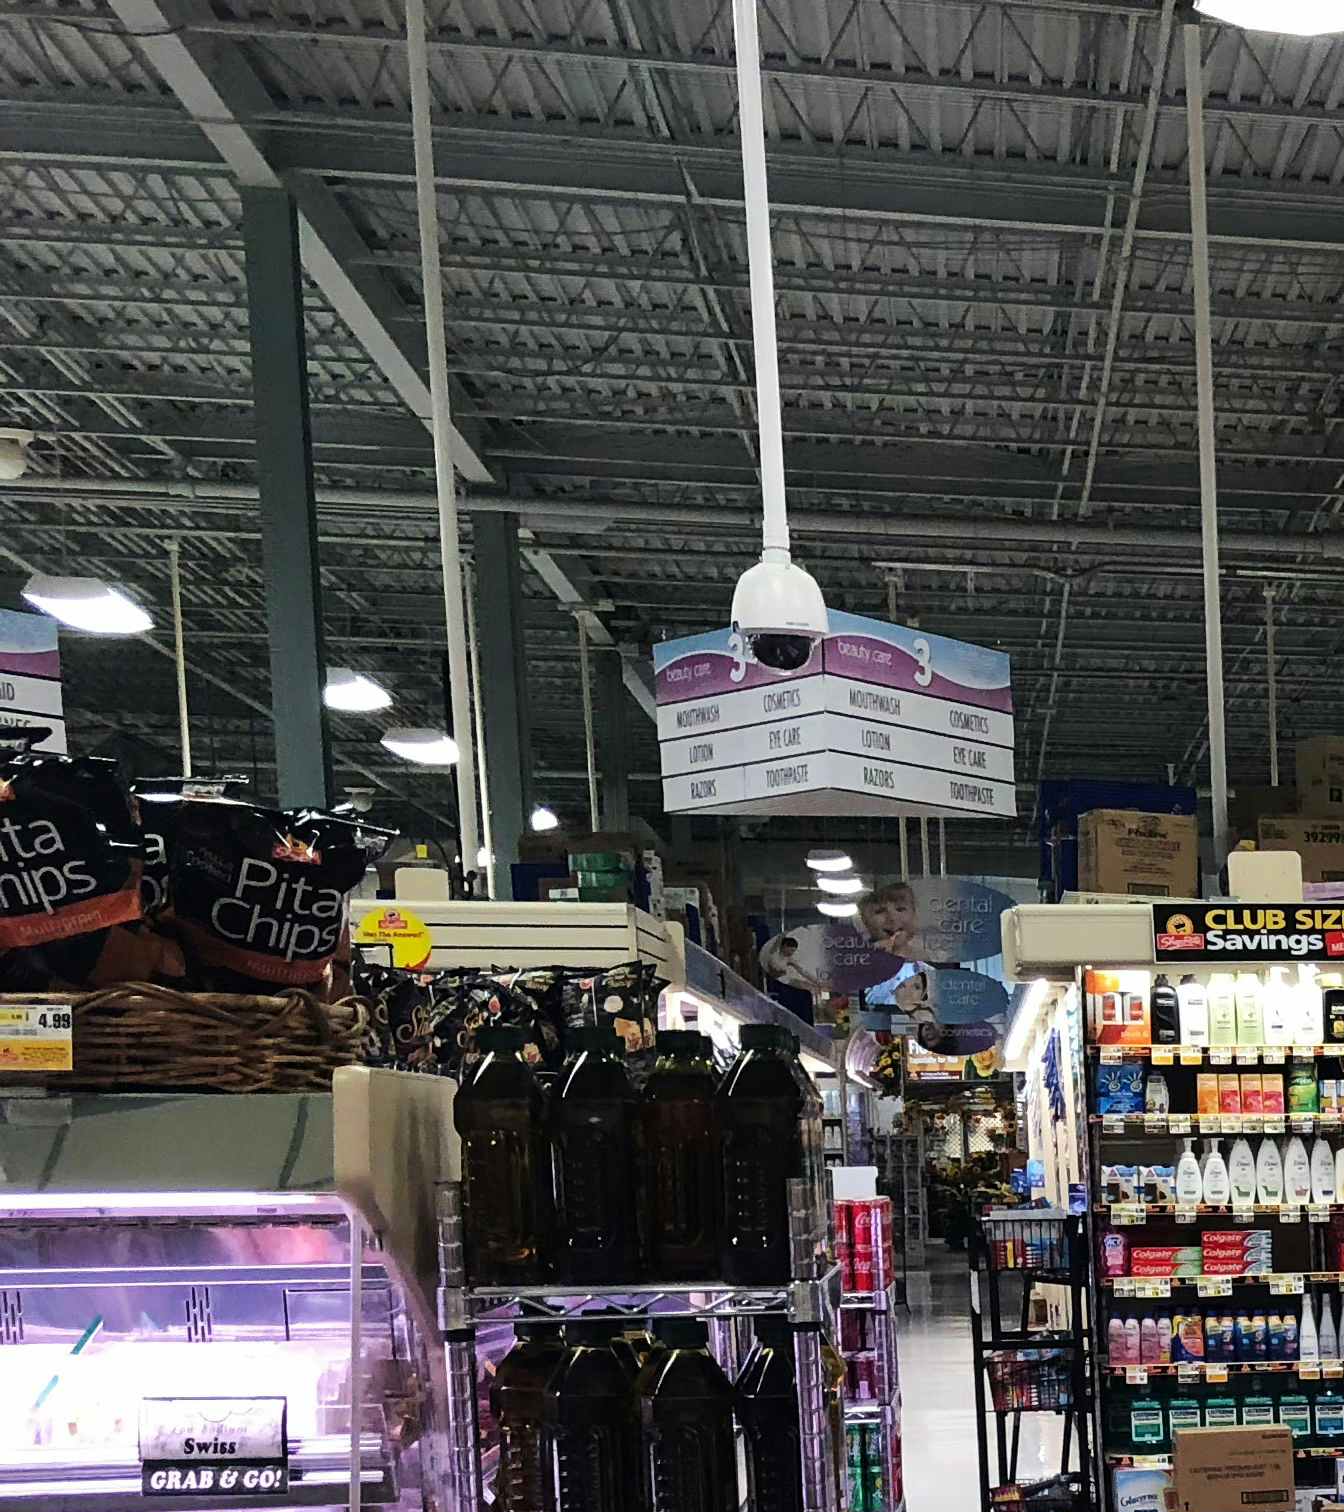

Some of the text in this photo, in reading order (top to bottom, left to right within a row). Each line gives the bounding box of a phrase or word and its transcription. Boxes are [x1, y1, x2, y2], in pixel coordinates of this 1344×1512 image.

[728, 633, 747, 683] 3
[837, 641, 892, 666] beauty care
[913, 638, 934, 688] 3
[666, 663, 712, 682] beauty care
[763, 689, 800, 713] COSMETICS
[849, 688, 900, 716] MOUTHWASH
[677, 705, 720, 728] MOUTHWASH
[950, 709, 988, 733] COSMETICS
[769, 727, 800, 749] EYE CARE
[862, 729, 891, 751] LOTION
[690, 743, 713, 763] LOTION
[953, 745, 986, 769] EYE CARE
[766, 765, 808, 788] TOOTHPASTE
[863, 767, 894, 789] RAZORS
[691, 779, 717, 799] RAZORS
[950, 781, 994, 806] TOOTHPASTE
[236, 858, 342, 919] Pita
[212, 897, 339, 962] Chips
[940, 918, 984, 934] care
[1205, 909, 1285, 929] CLUB
[1206, 929, 1323, 955] Savings
[833, 952, 871, 966] care
[38, 1013, 70, 1029] 4.99
[1204, 1234, 1243, 1244] Colgate
[1204, 1248, 1242, 1258] Colgate
[1204, 1263, 1243, 1273] Colgate
[184, 1437, 236, 1455] Swiss
[150, 1469, 283, 1489] GRAB & GO!
